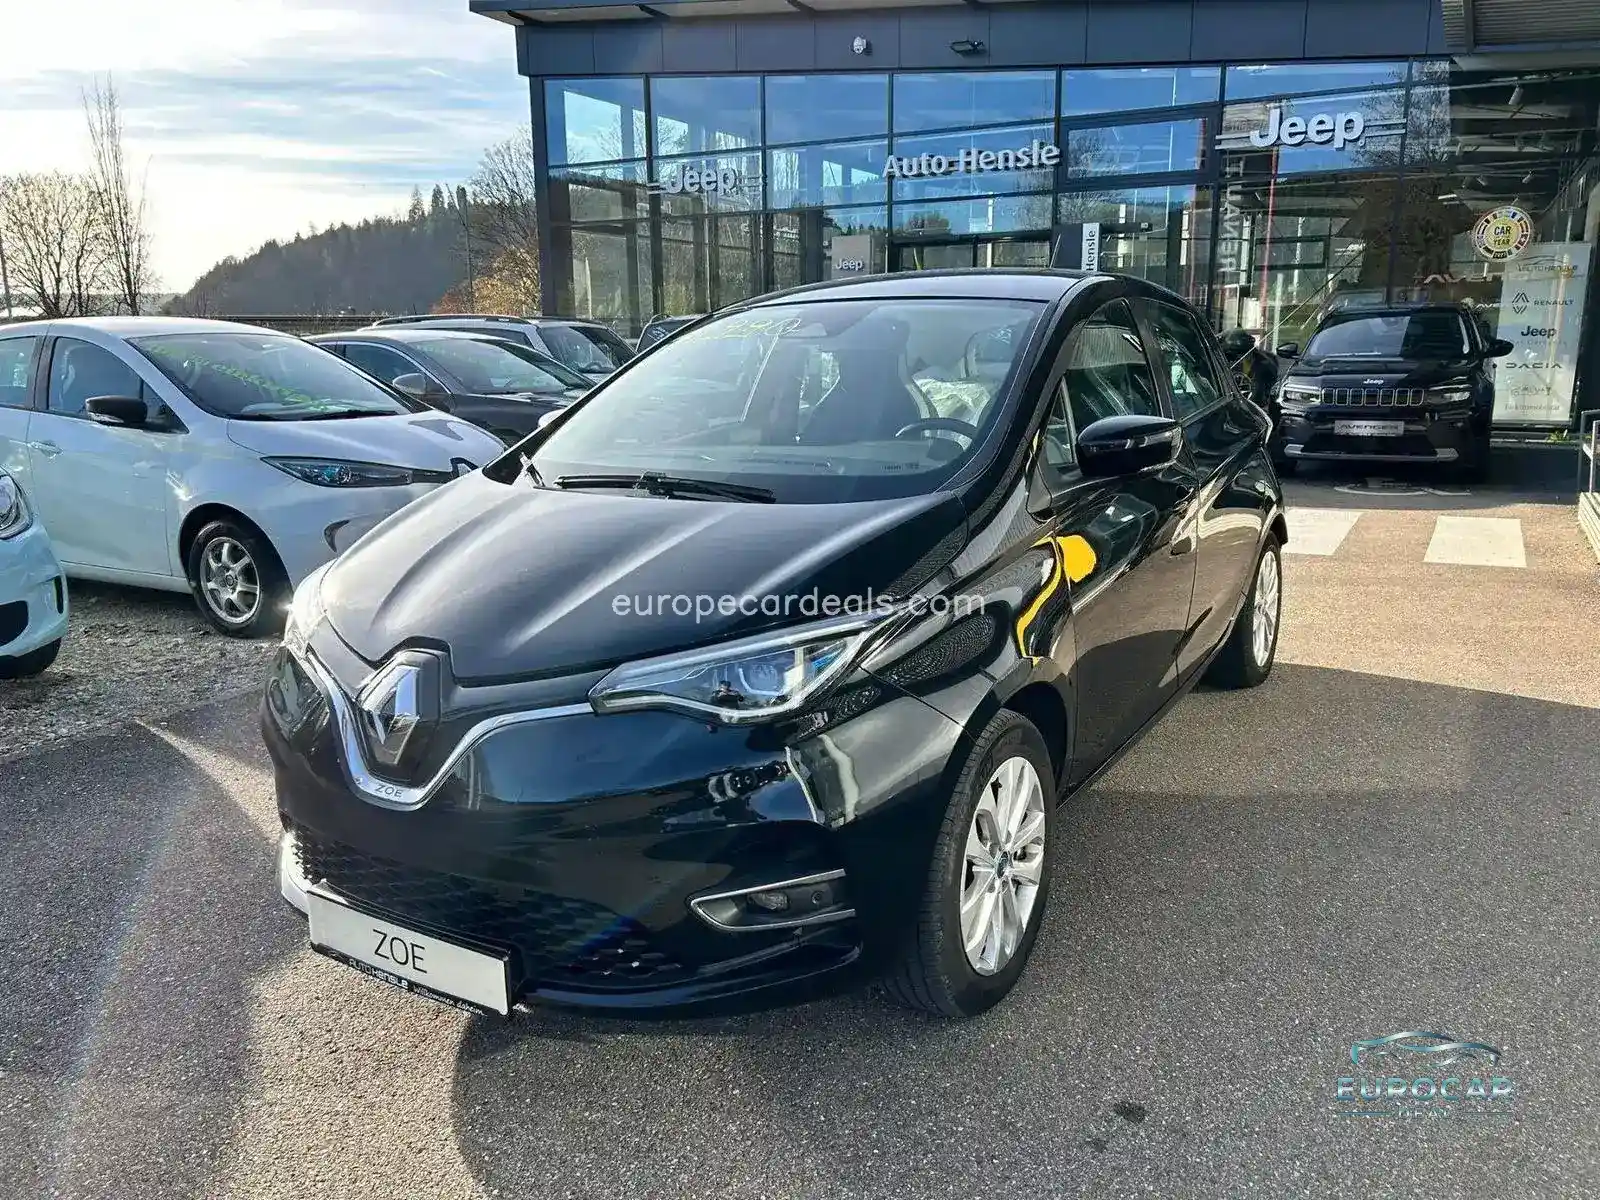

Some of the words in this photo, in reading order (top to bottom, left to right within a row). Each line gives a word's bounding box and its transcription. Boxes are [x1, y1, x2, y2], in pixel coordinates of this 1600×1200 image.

[1250, 108, 1364, 149] Jeep
[882, 152, 948, 178] Auto
[959, 139, 1060, 172] Hensle
[666, 163, 736, 195] Jeep
[1494, 226, 1511, 236] CAR
[836, 258, 863, 271] Jeep
[1086, 230, 1096, 271] Hensle
[1521, 326, 1556, 338] Jeep
[375, 785, 403, 798] ZOE
[372, 928, 428, 974] ZOE
